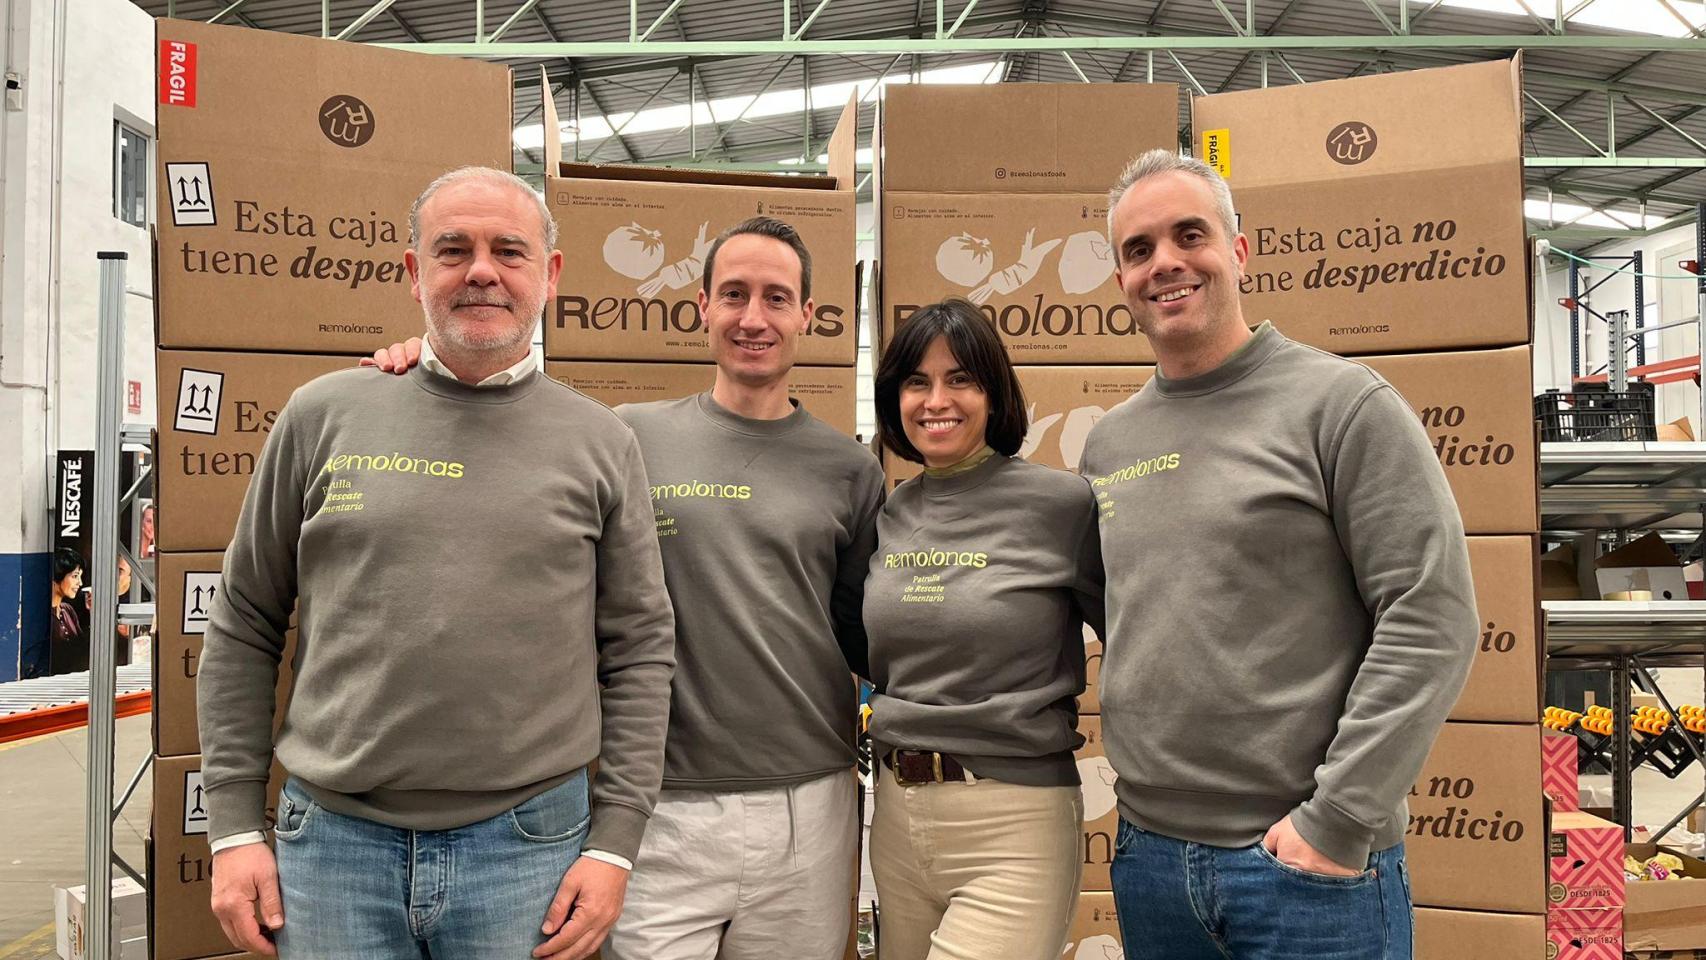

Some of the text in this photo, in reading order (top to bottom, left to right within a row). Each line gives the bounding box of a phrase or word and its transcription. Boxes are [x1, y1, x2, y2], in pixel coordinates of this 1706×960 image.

[170, 42, 185, 104] FRAGIL
[234, 200, 399, 248] Esta caja
[1255, 218, 1457, 256] Esta caja no
[180, 242, 407, 289] tiene desper
[1238, 246, 1506, 294] ene desperdicio
[318, 322, 384, 335] Remolonas
[1329, 324, 1390, 336] Remolonas
[234, 400, 278, 433] Es
[1421, 405, 1465, 428] no
[179, 445, 255, 476] tien
[61, 459, 82, 537] NESCAFÉ
[647, 479, 752, 500] emolonas
[655, 518, 675, 527] scate
[884, 547, 988, 569] Remolonas
[904, 584, 945, 593] de Rescate
[912, 573, 941, 584] Patrulla
[900, 594, 945, 603] Alimentario
[1428, 776, 1474, 799] no
[1570, 889, 1611, 898] DESDE 1825
